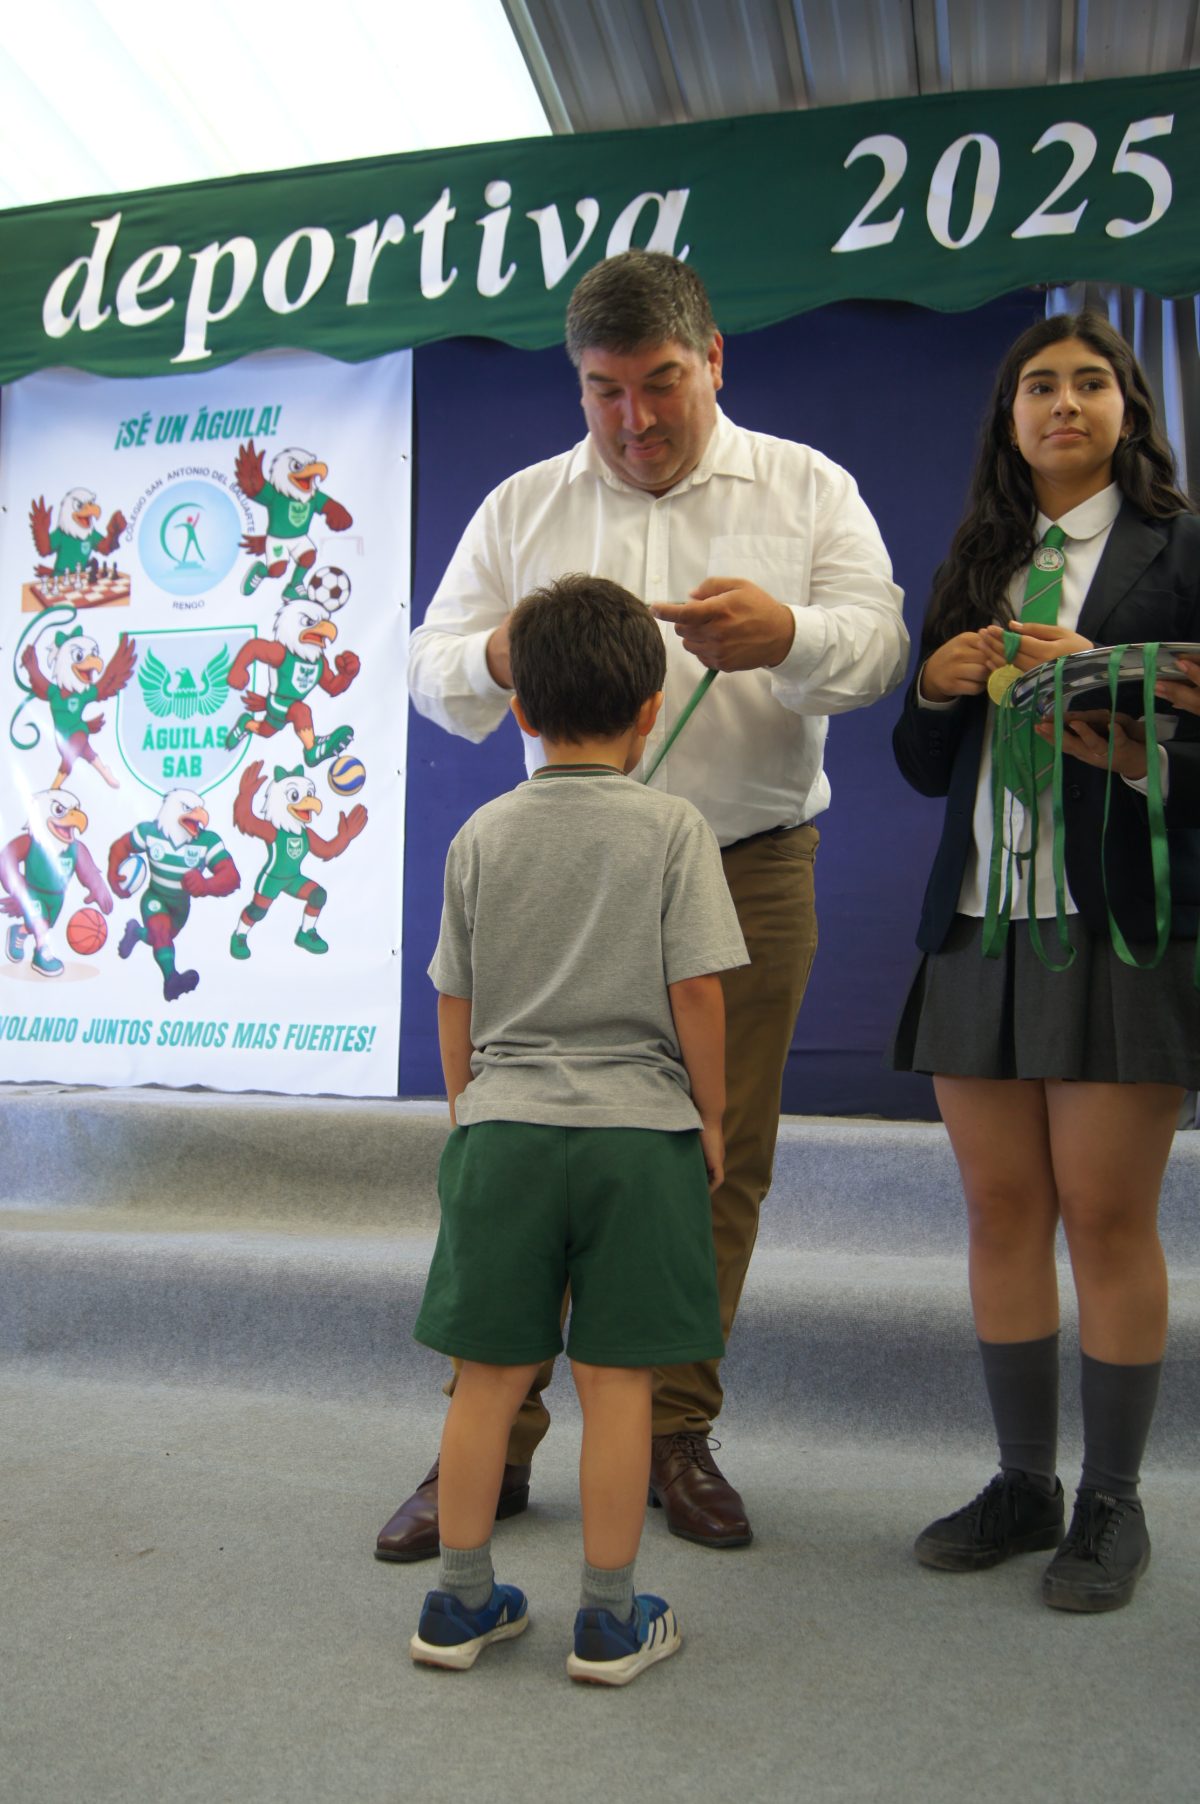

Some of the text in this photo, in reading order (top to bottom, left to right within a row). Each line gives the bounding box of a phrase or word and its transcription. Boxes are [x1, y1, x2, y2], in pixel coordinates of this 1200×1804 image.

[42, 114, 1175, 364] deportiva 2025
[114, 405, 283, 450] ¡SÉ UN ÁGUILA!
[125, 496, 147, 542] COLEGIO
[145, 478, 164, 499] SAN
[166, 466, 211, 481] ANTONIO
[211, 469, 229, 486] DEL
[172, 600, 205, 610] RENGO
[142, 723, 230, 751] ÁGUILAS
[162, 755, 203, 778] SAB
[82, 1018, 153, 1046] JUNTOS
[156, 1020, 229, 1048] SOMOS
[231, 1022, 281, 1050] MAS
[283, 1024, 377, 1052] FUERTES!
